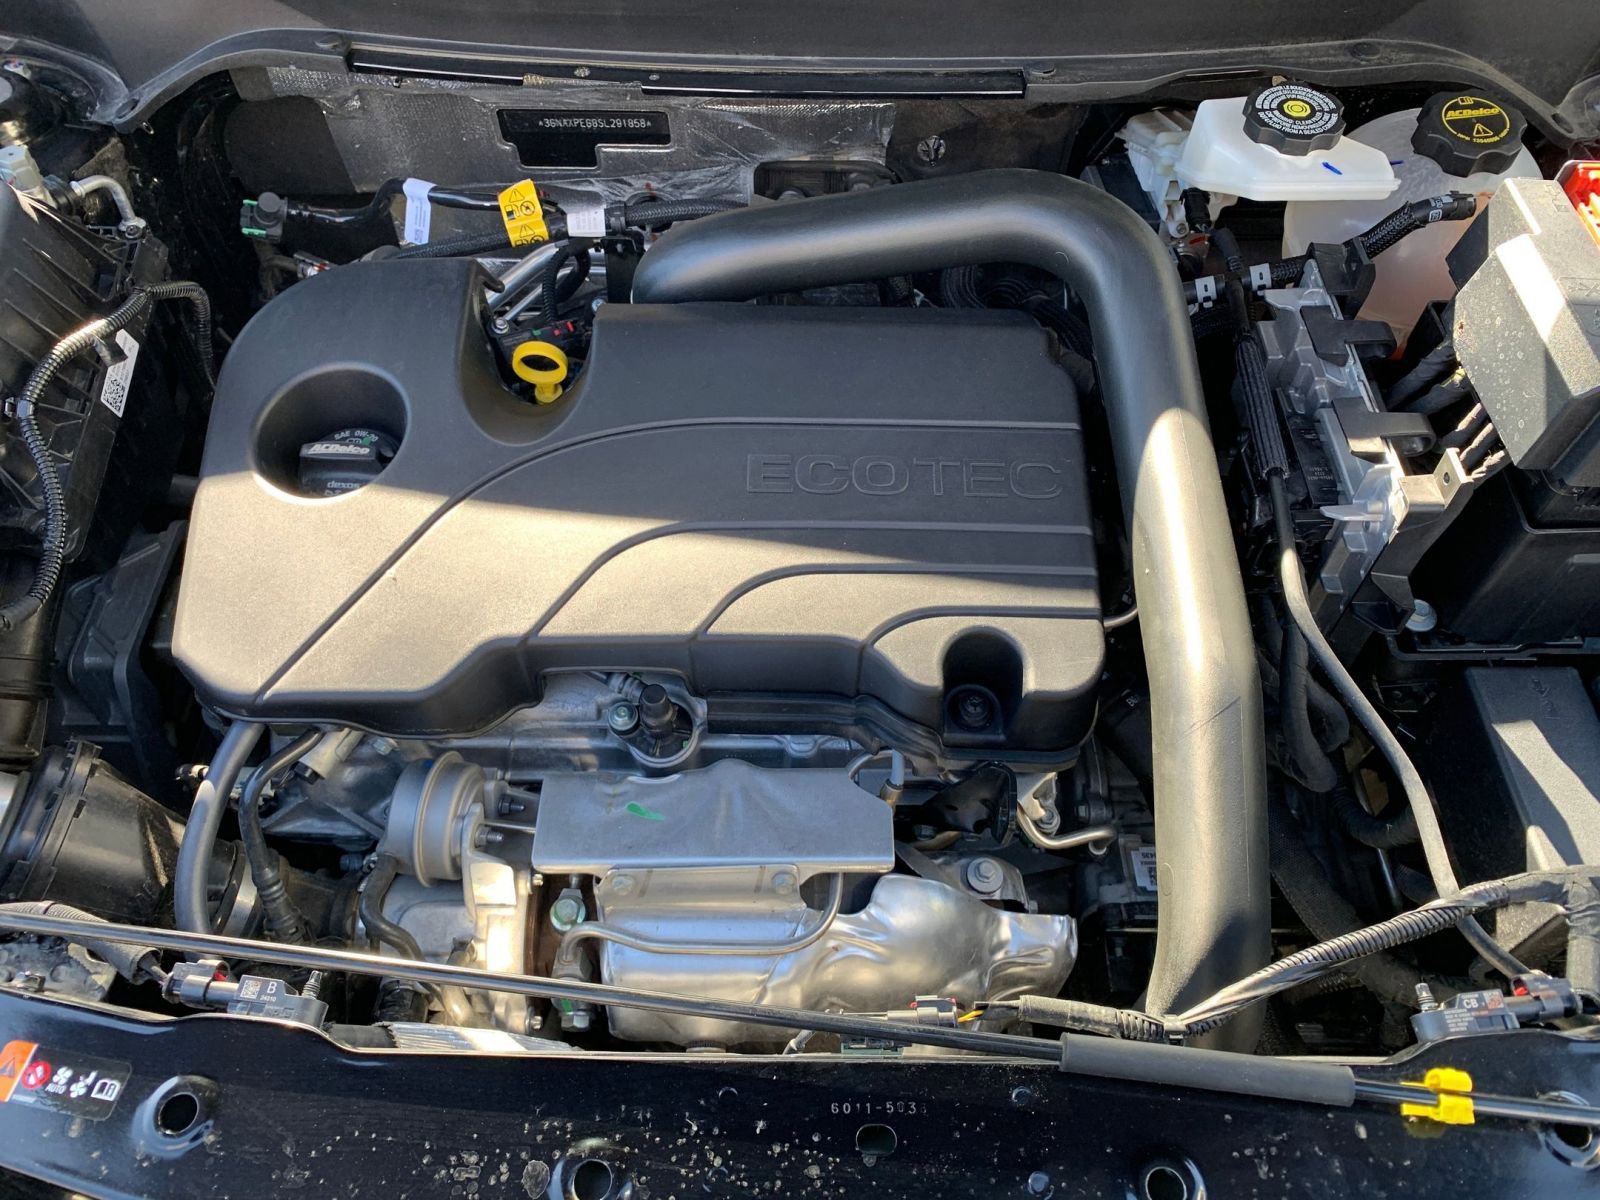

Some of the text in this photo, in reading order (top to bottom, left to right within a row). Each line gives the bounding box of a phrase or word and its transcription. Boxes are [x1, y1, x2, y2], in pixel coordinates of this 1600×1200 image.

[1446, 107, 1500, 119] ACDelco
[334, 430, 350, 440] SAE
[308, 443, 370, 454] ACDelco
[747, 454, 1064, 499] ECOTEC
[267, 982, 277, 993] B
[1463, 999, 1478, 1008] CB
[45, 1082, 67, 1094] AUTO
